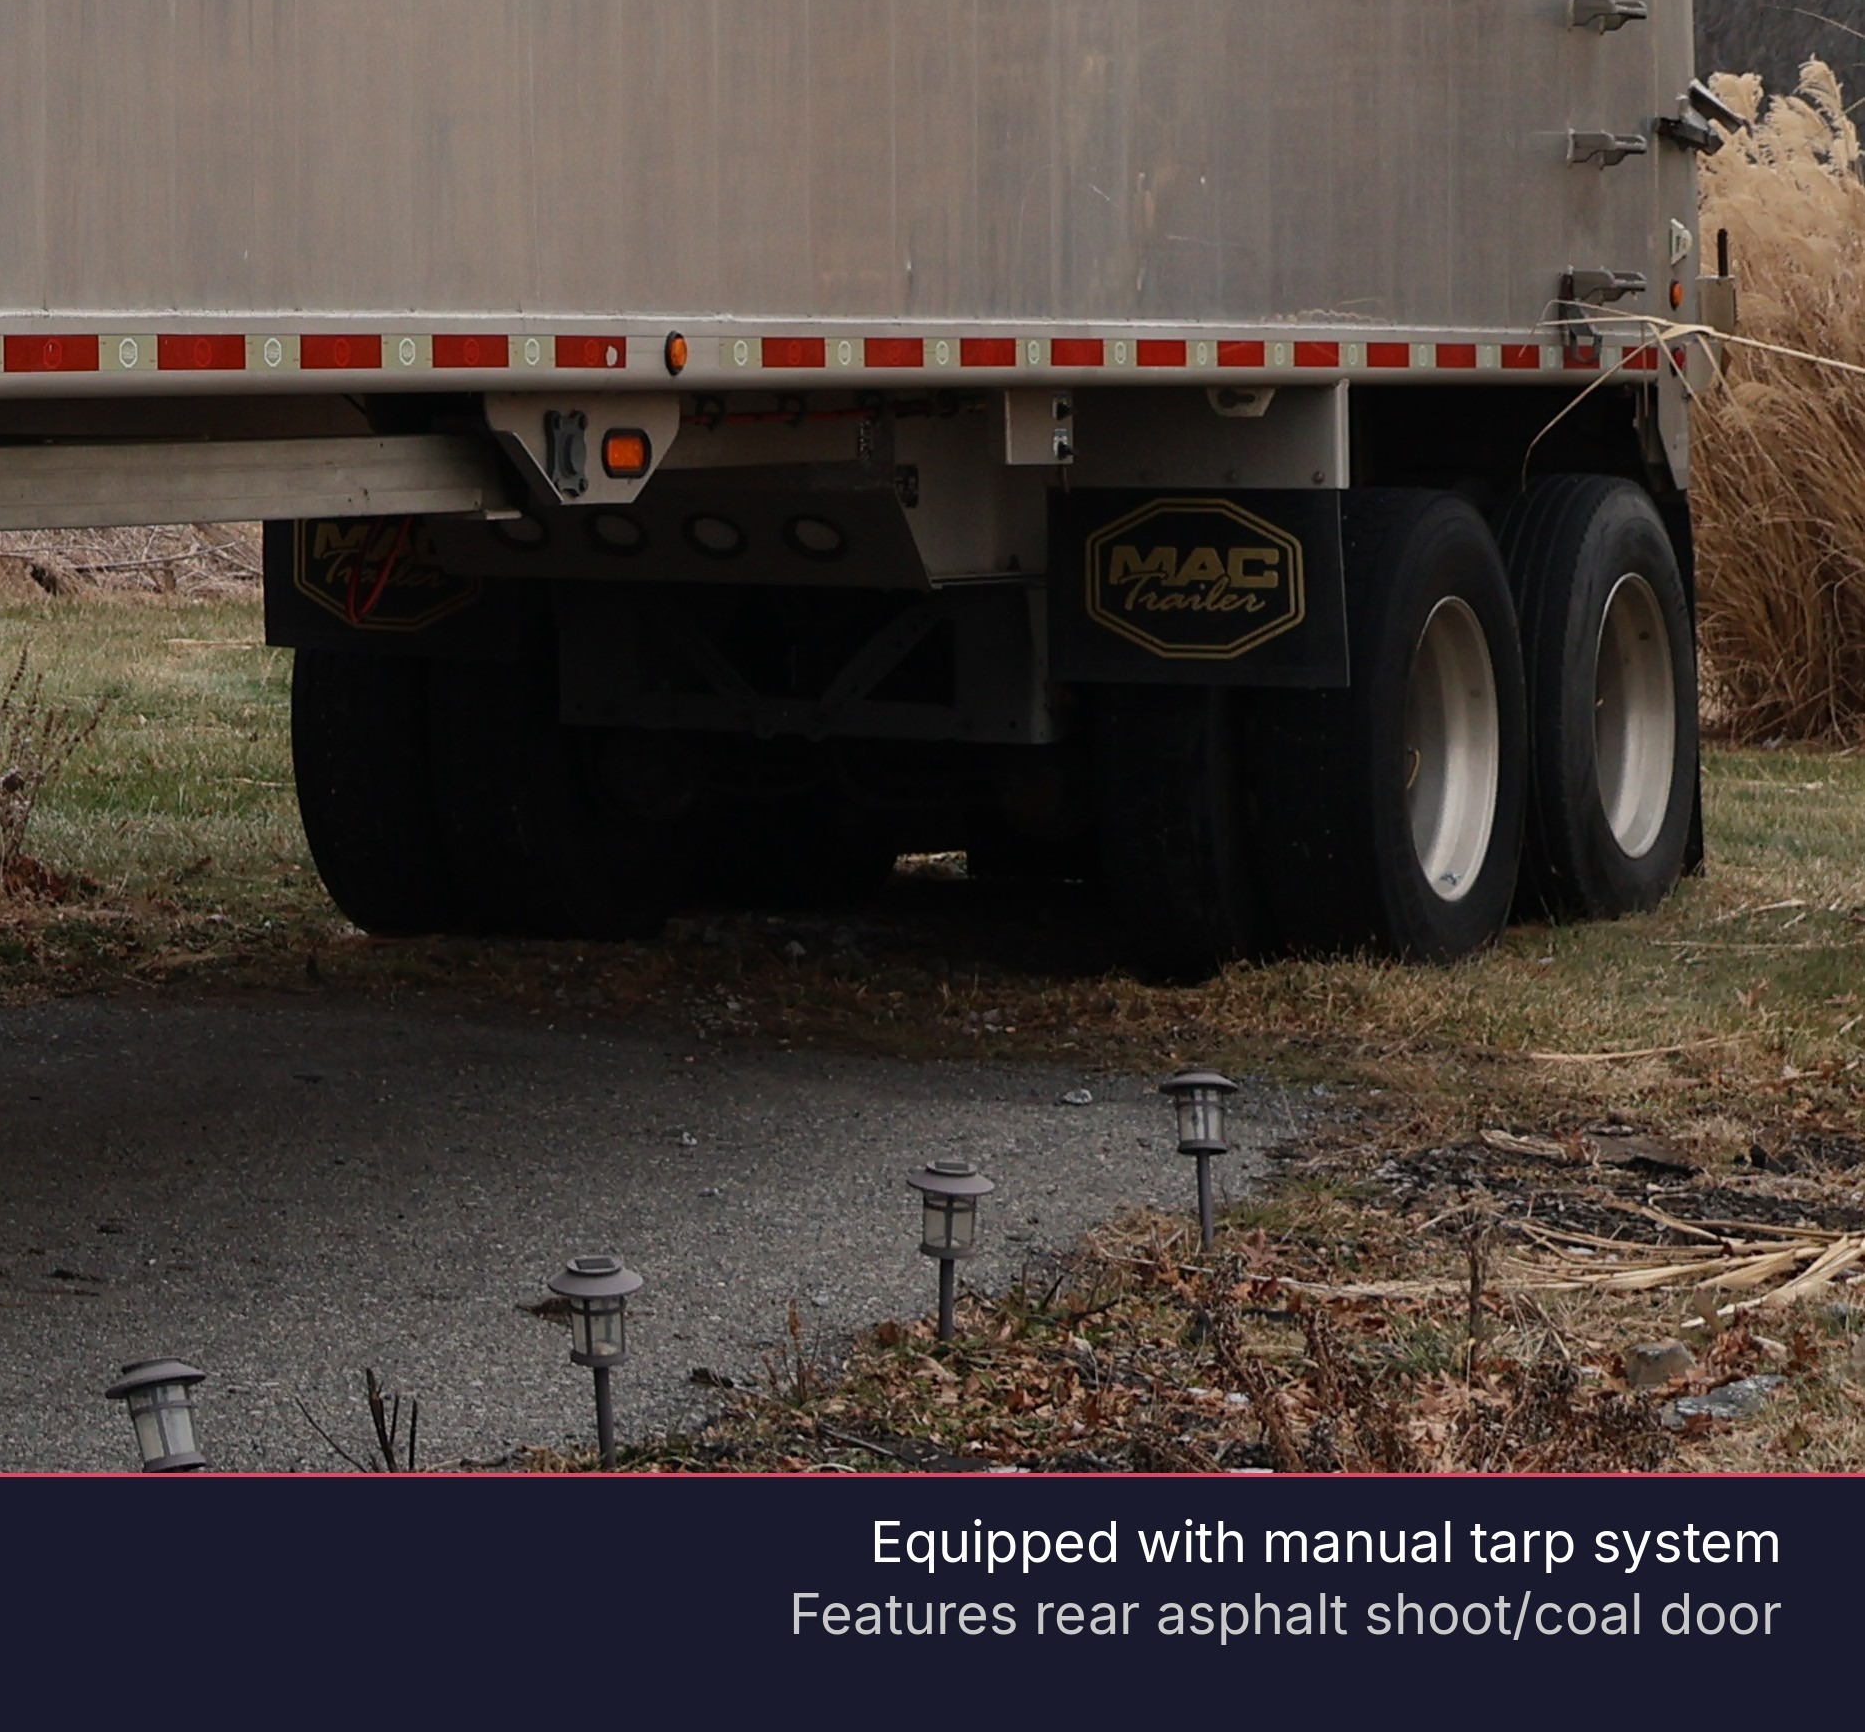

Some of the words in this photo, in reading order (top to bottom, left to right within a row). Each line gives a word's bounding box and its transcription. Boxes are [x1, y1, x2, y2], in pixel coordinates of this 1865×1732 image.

[323, 548, 447, 589] Traler
[1109, 546, 1280, 588] MAC
[1120, 570, 1266, 612] Trailer
